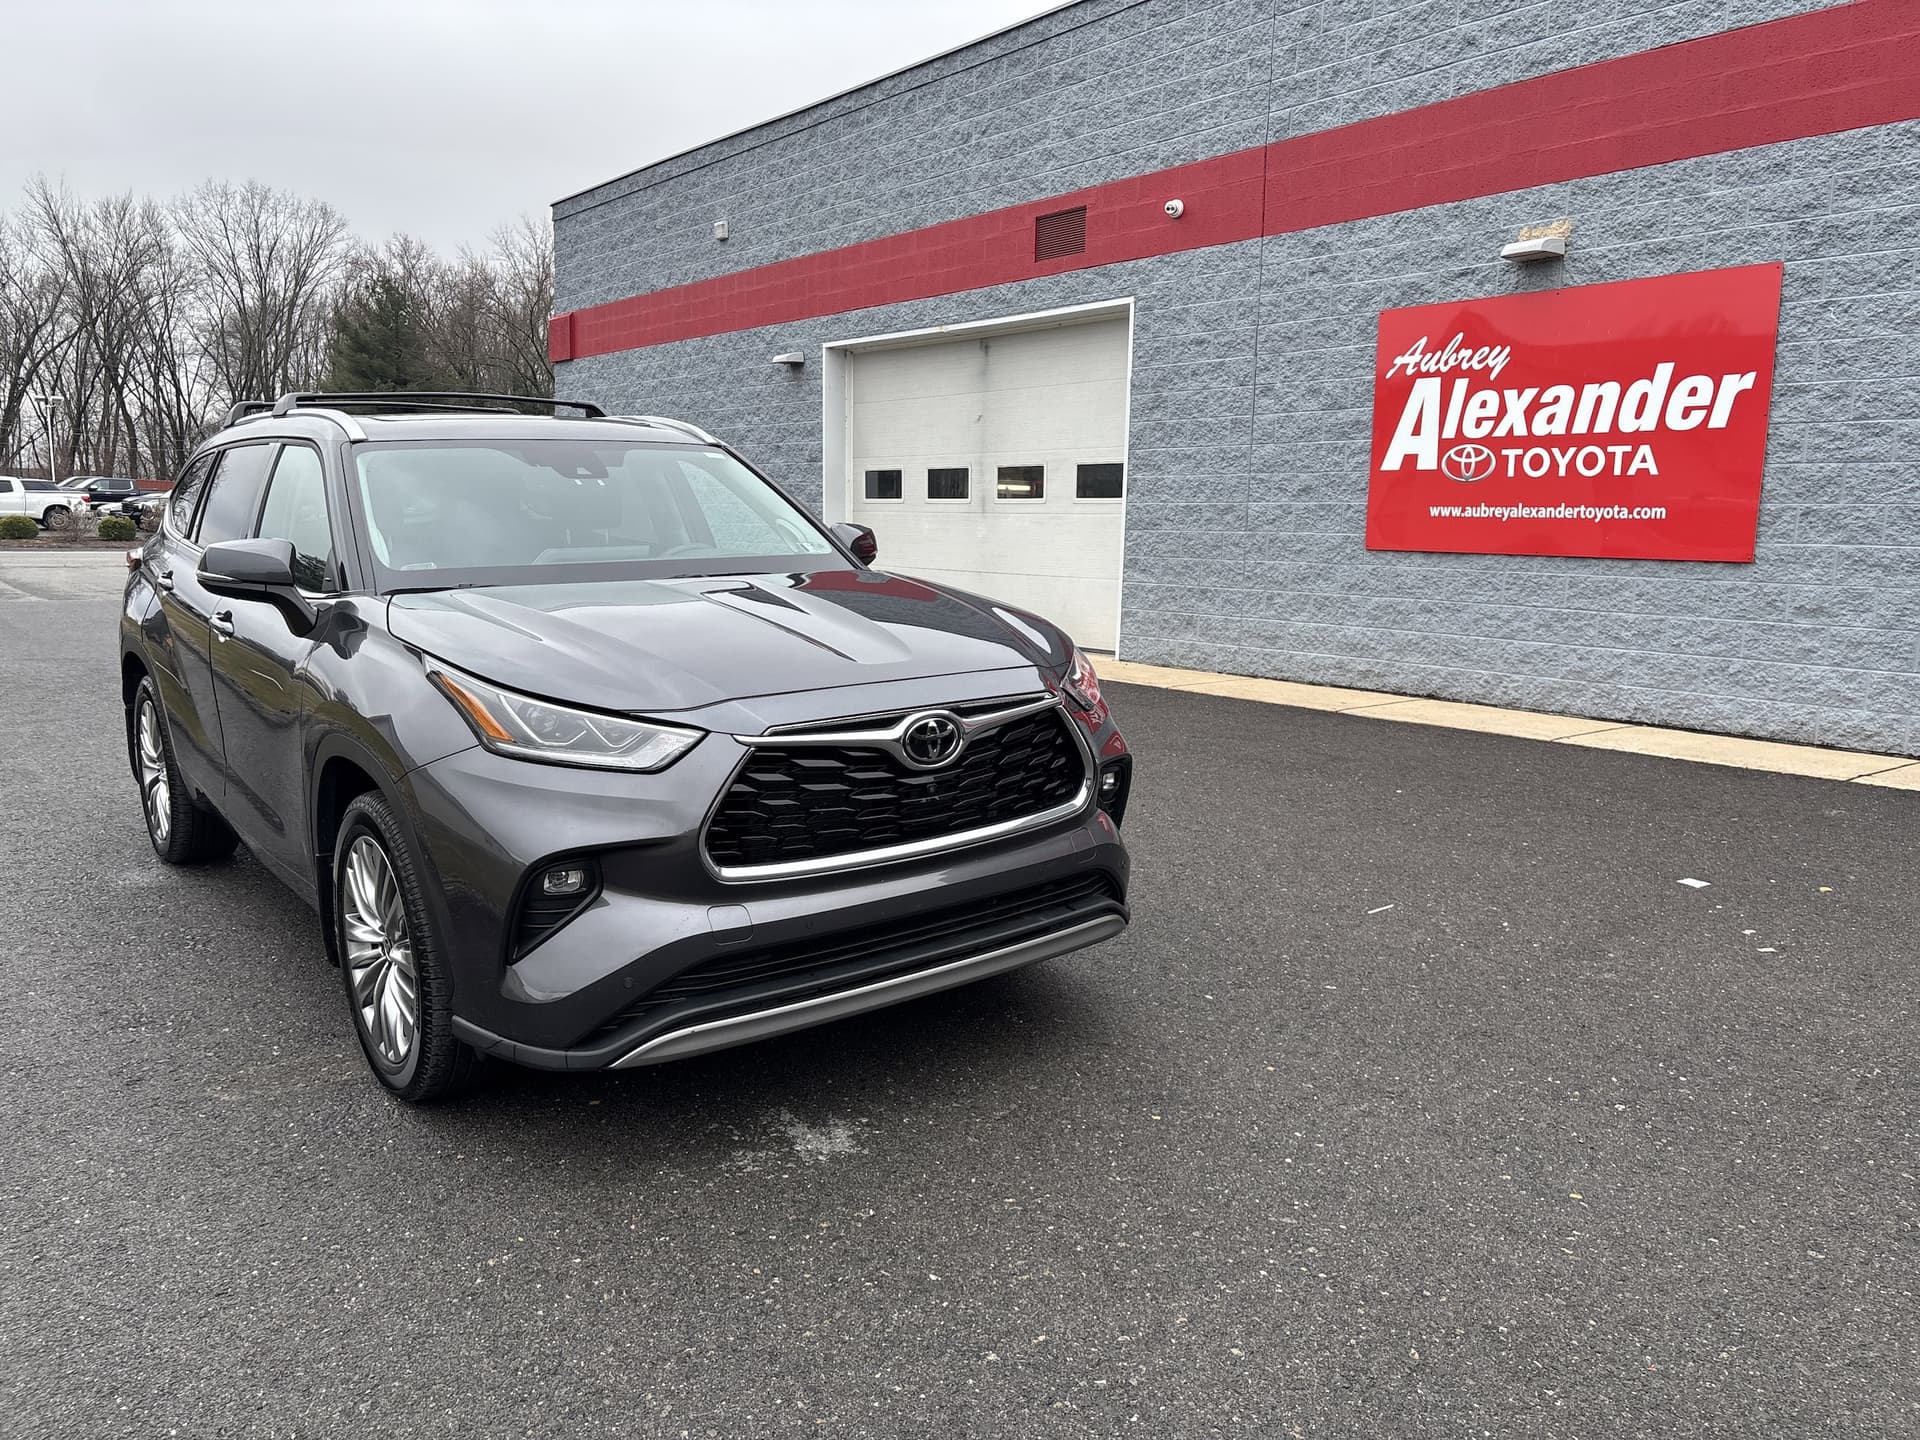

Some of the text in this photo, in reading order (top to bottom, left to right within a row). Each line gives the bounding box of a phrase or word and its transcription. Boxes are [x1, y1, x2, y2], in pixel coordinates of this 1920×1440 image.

[1385, 332, 1511, 381] Aubrey
[1380, 362, 1757, 471] Alexander
[1501, 445, 1659, 478] TOYOTA
[1429, 502, 1667, 523] www.aubreyalexandertoyota.com
